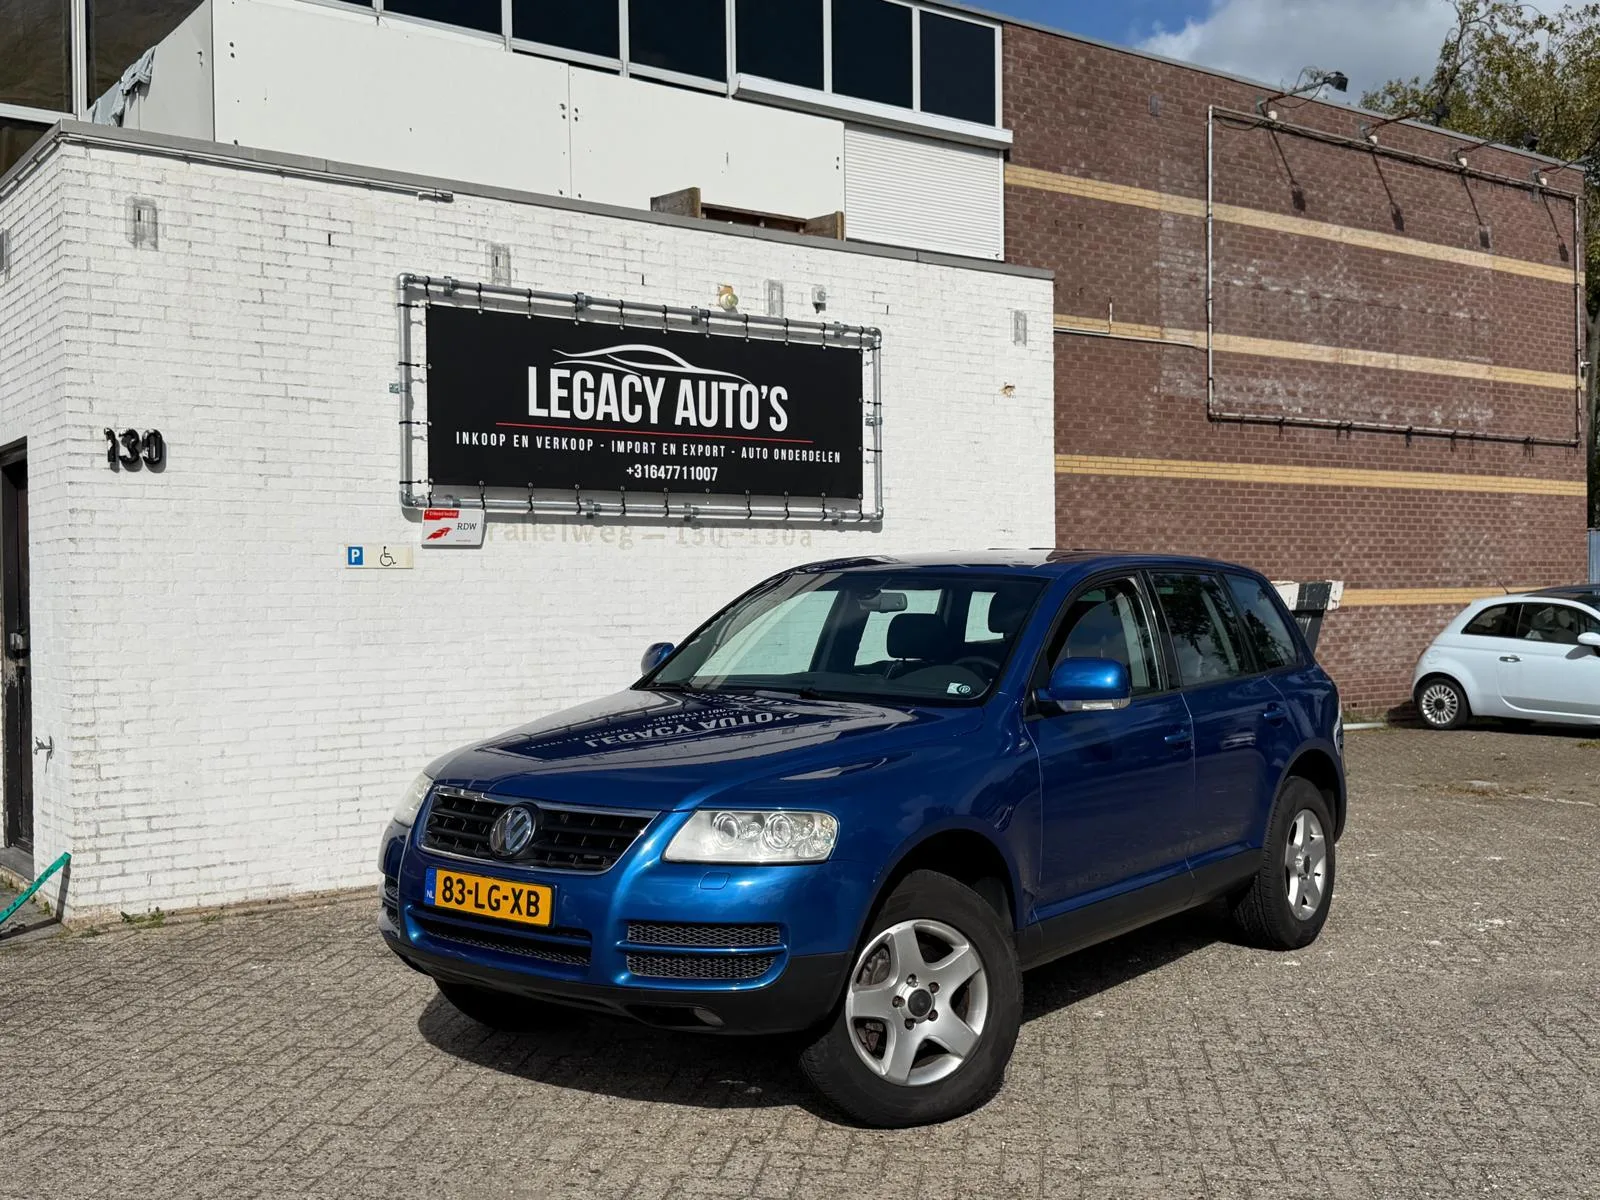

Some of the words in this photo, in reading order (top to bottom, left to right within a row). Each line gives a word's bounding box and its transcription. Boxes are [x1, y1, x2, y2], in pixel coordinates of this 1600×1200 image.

[528, 366, 667, 424] LEGACY
[674, 379, 788, 431] AUTO'S
[104, 428, 163, 464] 130
[456, 431, 506, 446] INKOOP
[513, 434, 529, 448] EN
[536, 436, 594, 451] VERKOOP
[611, 440, 656, 454] IMPORT
[662, 443, 676, 455] EN
[682, 444, 726, 457] EXPORT
[741, 446, 768, 459] AUTO
[773, 448, 841, 463] ONDERDELEN
[626, 463, 718, 481] +31647711007
[457, 522, 477, 531] RDW
[485, 514, 635, 551] rallelweg
[351, 548, 361, 563] P
[442, 876, 540, 917] 83-LG-XB
